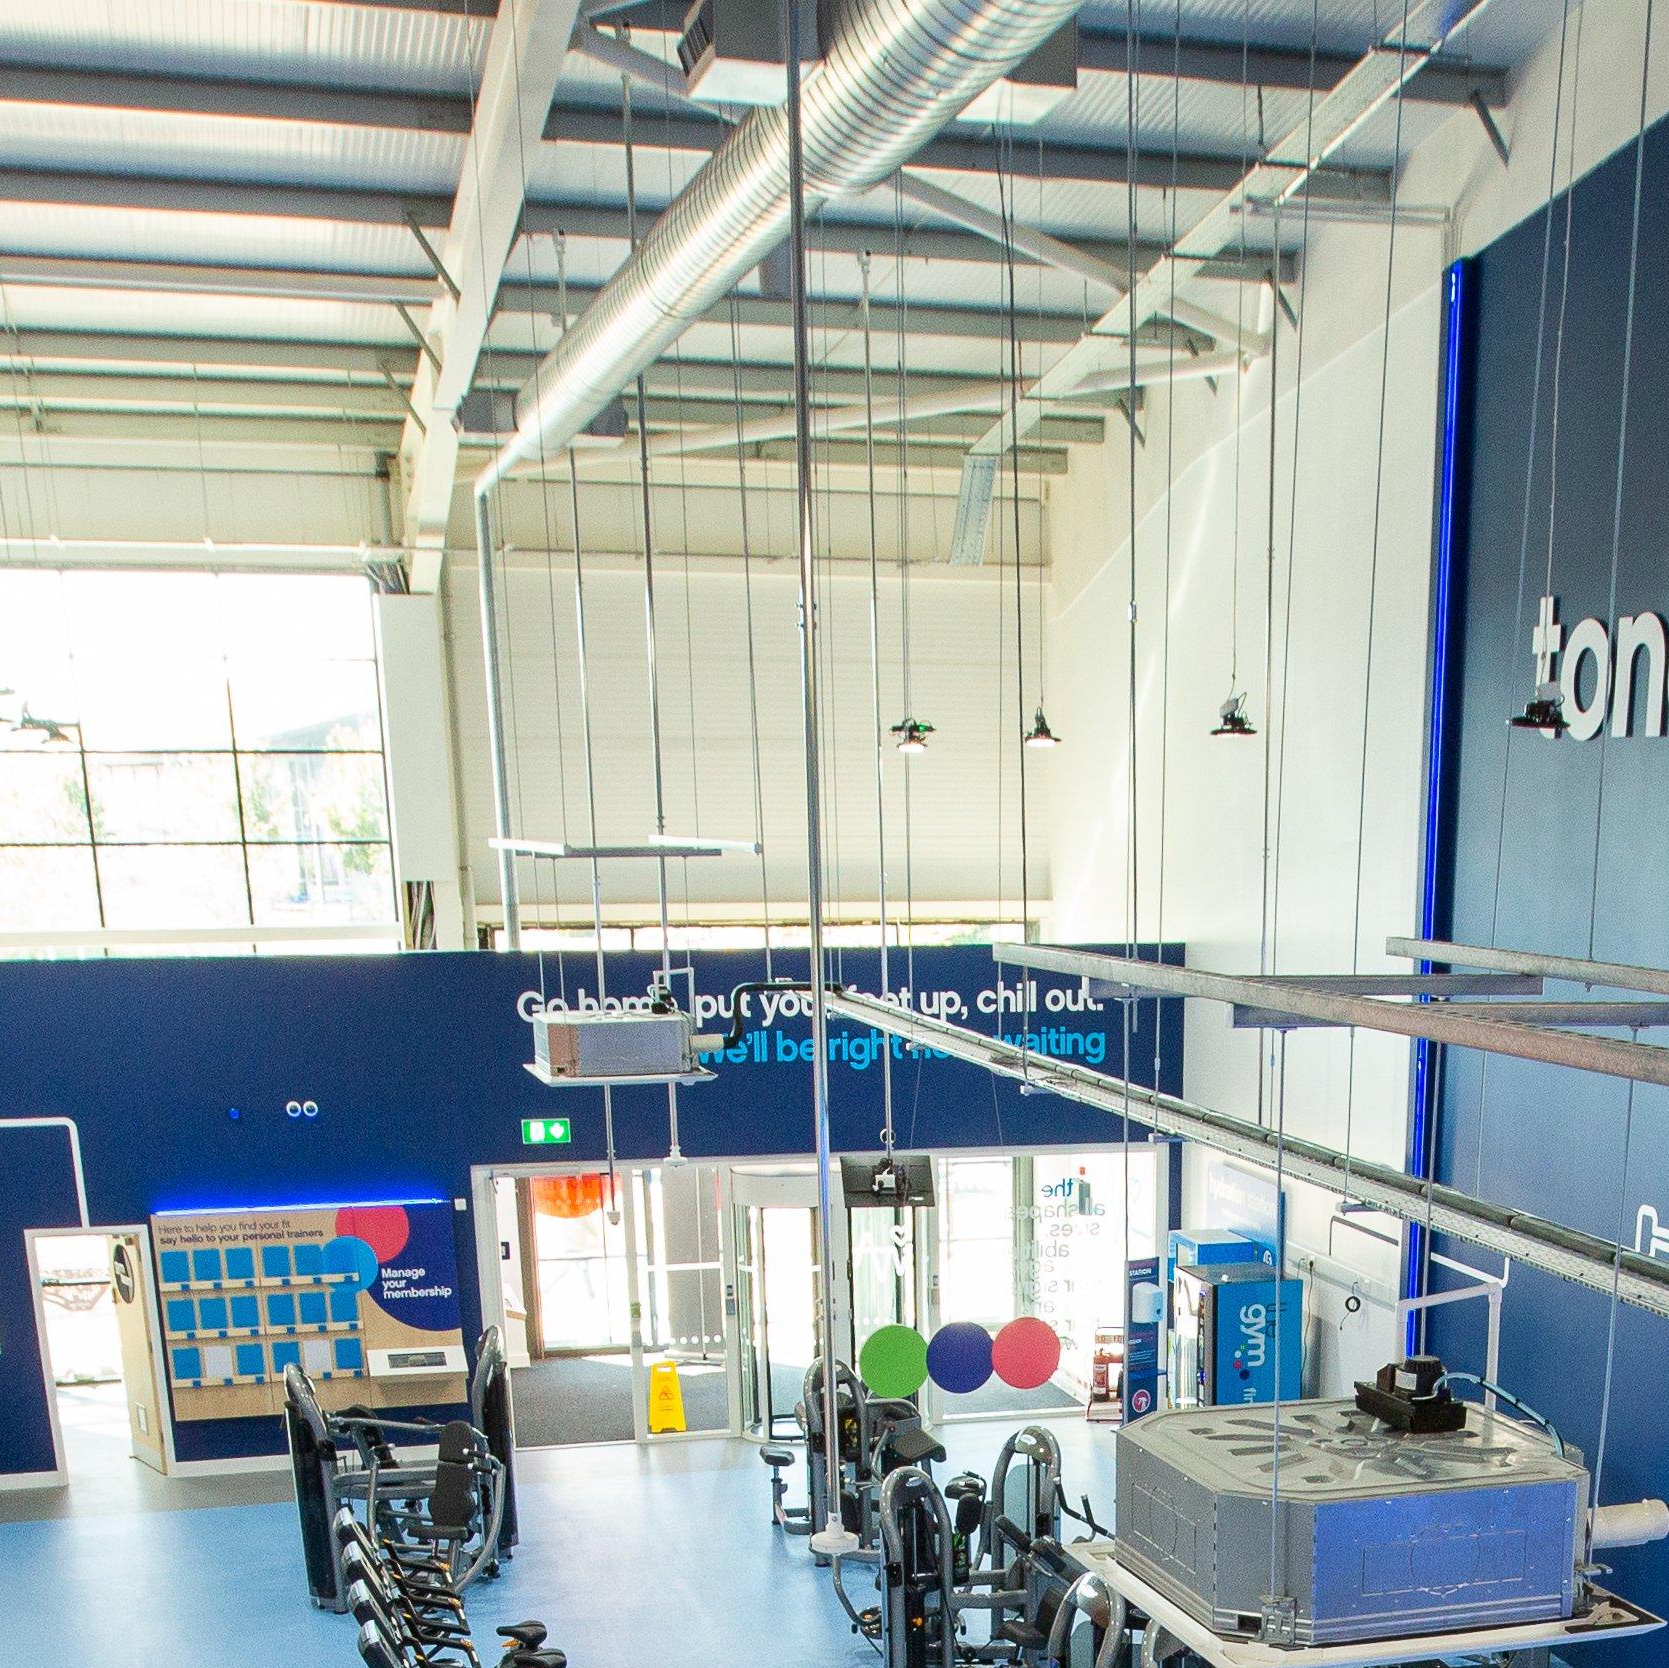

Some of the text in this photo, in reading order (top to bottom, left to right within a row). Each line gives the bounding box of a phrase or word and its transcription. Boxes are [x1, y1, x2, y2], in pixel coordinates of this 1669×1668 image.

[695, 991, 752, 1027] put
[759, 992, 815, 1027] you
[920, 990, 968, 1022] up,
[977, 981, 1036, 1013] chill
[1045, 979, 1103, 1012] out.
[776, 1031, 815, 1062] be
[829, 1029, 902, 1069] right
[196, 1222, 217, 1233] help
[219, 1223, 236, 1233] you
[239, 1220, 256, 1230] find
[160, 1229, 324, 1246] say hello to your personal trainers
[381, 1267, 426, 1279] Manage
[382, 1279, 406, 1290] your
[383, 1285, 452, 1299] membership
[1239, 1303, 1266, 1367] gym
